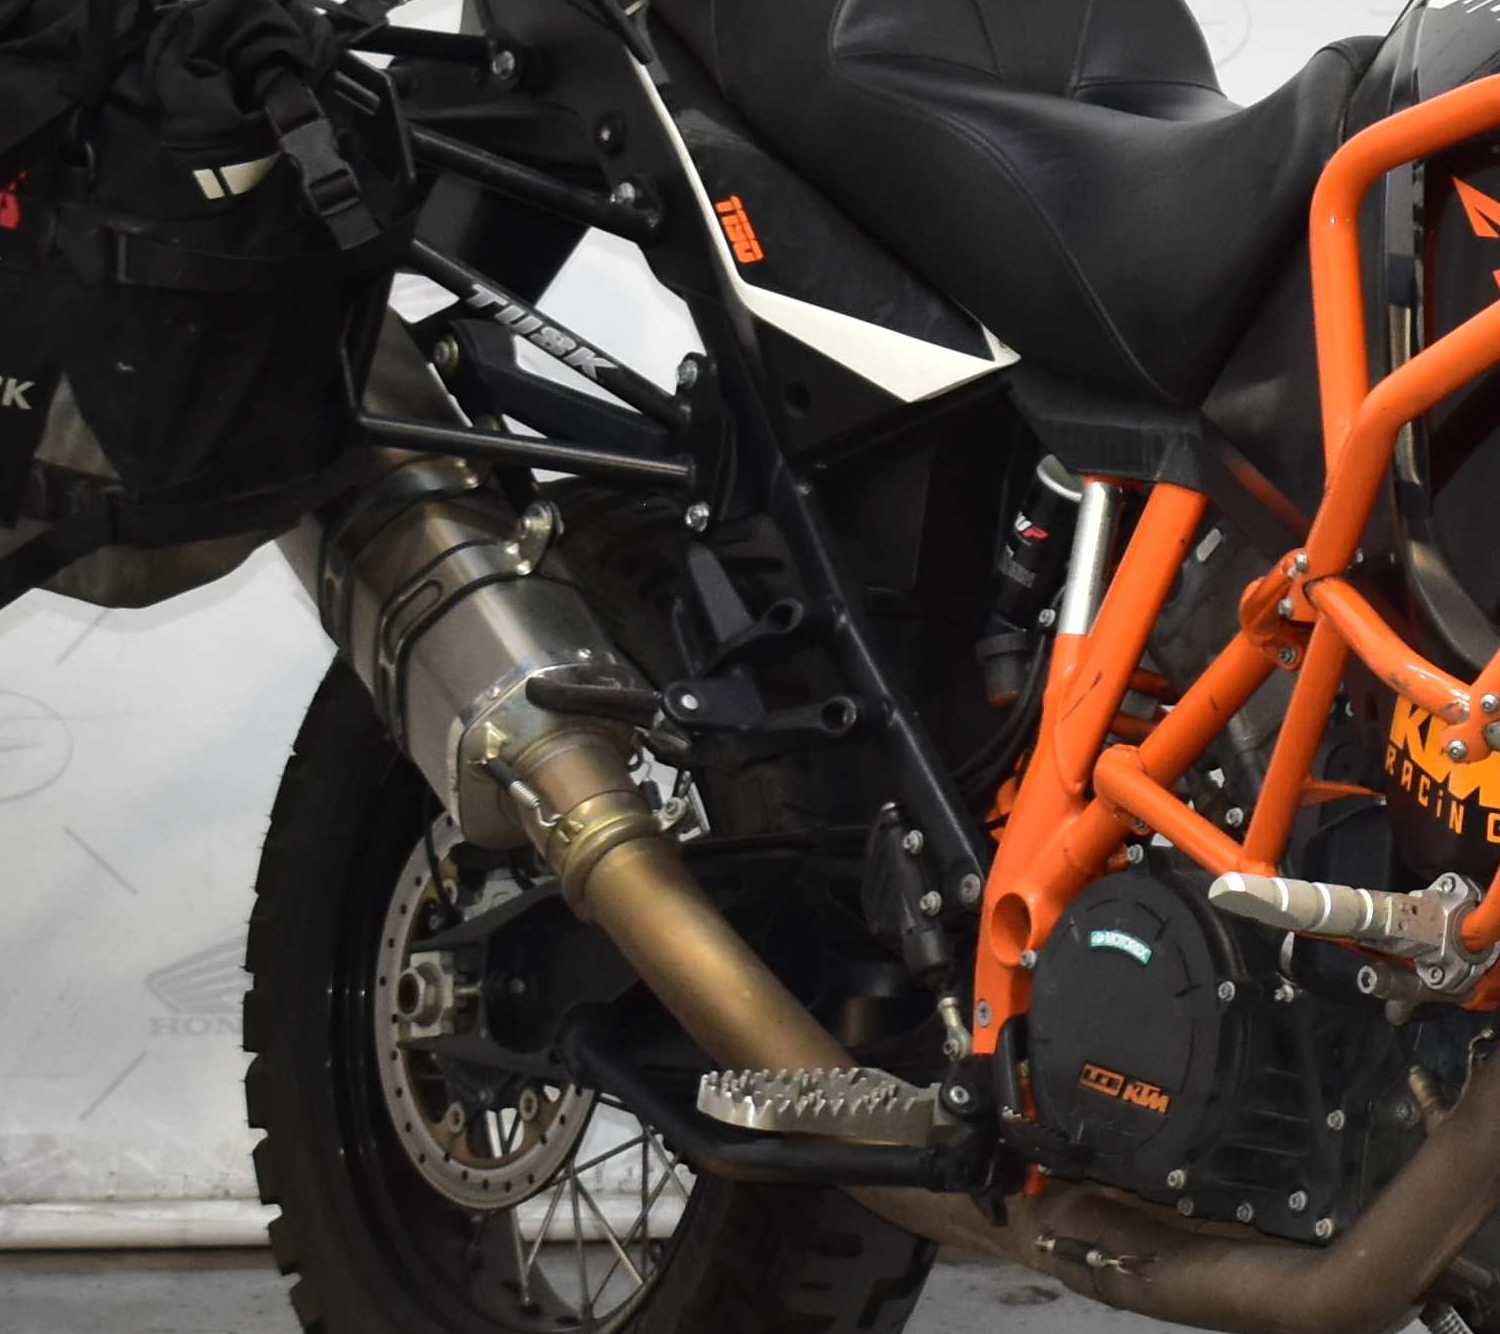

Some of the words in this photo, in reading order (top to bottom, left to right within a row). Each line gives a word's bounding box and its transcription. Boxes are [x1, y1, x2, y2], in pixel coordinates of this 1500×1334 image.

[468, 284, 619, 379] TUSK
[147, 1015, 243, 1036] HON
[1122, 1081, 1170, 1113] KTM
